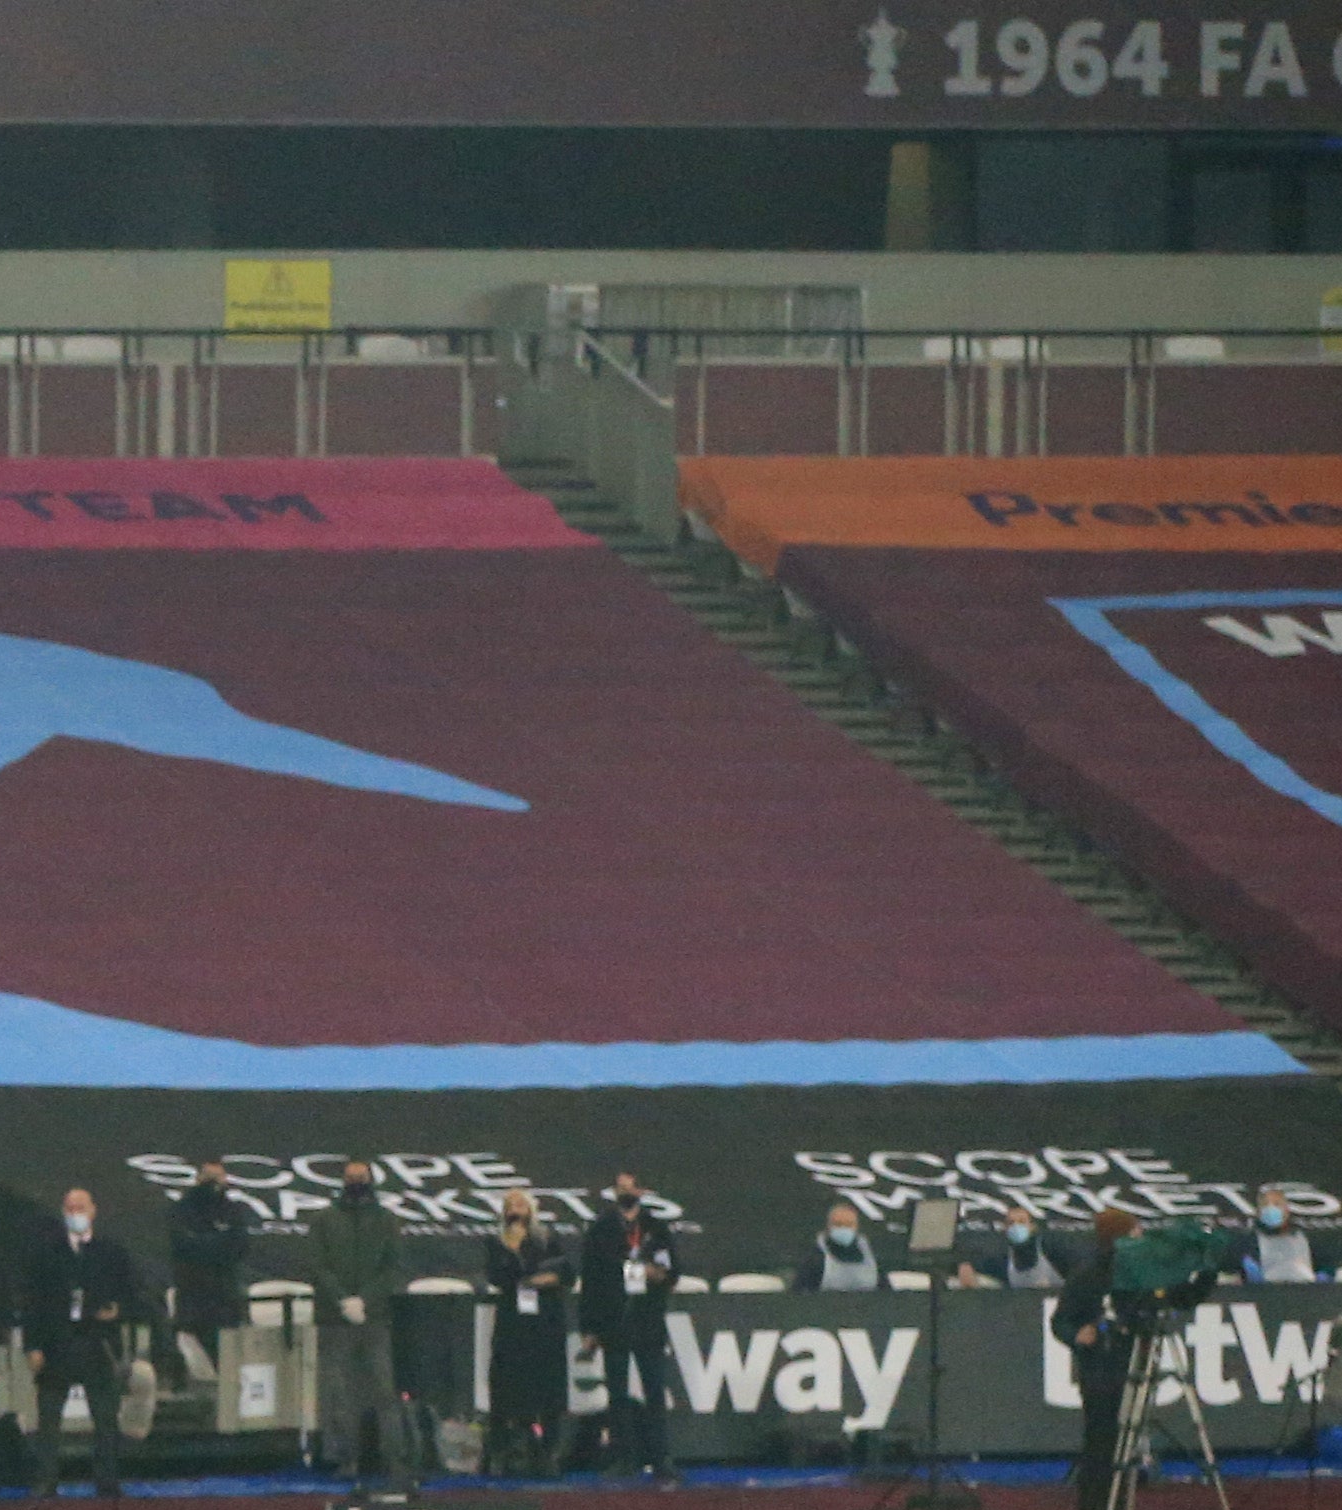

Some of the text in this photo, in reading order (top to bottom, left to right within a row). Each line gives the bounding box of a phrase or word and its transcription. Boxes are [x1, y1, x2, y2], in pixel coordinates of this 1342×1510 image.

[943, 18, 1170, 97] 1964
[1200, 20, 1308, 97] FA
[126, 1152, 532, 1188] SCOPE
[793, 1147, 1190, 1188] SCOPE
